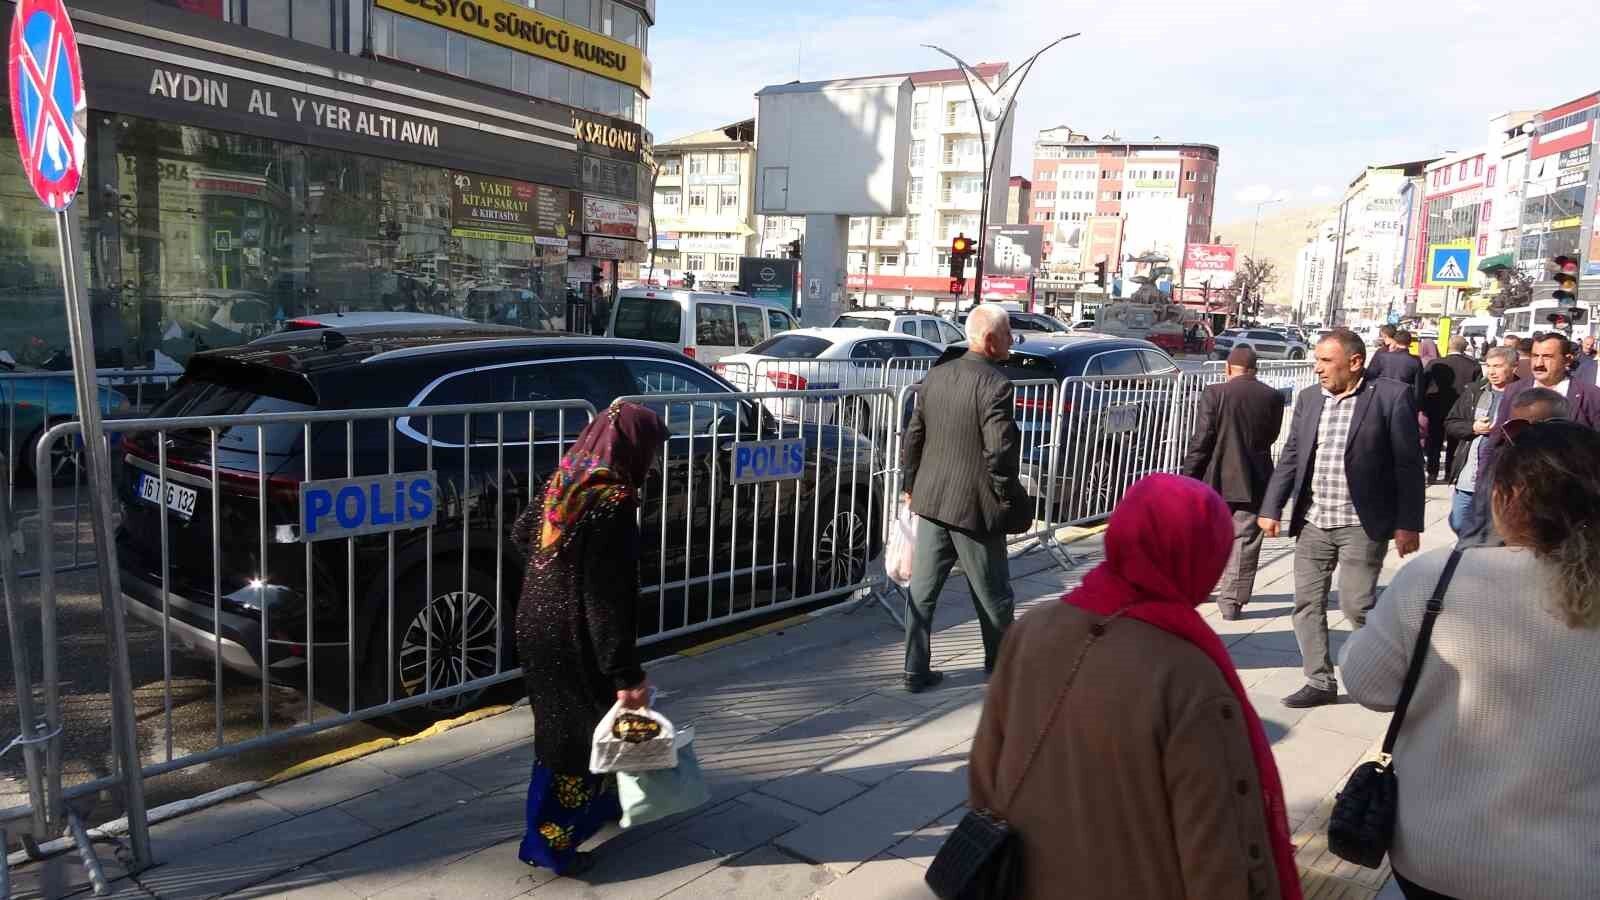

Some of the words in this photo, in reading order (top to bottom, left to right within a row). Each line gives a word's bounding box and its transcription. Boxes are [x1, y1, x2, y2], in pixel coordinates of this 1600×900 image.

[494, 12, 569, 53] SÜRÜCÜ
[572, 39, 627, 72] KURSU
[149, 68, 228, 108] AYDIN
[311, 101, 352, 131] YER
[355, 111, 397, 140] ALTI
[400, 120, 439, 148] AVM
[585, 122, 636, 152] SALONU
[480, 182, 513, 196] VAKIF
[471, 208, 479, 217] &
[144, 478, 154, 497] 16
[177, 489, 195, 512] 132
